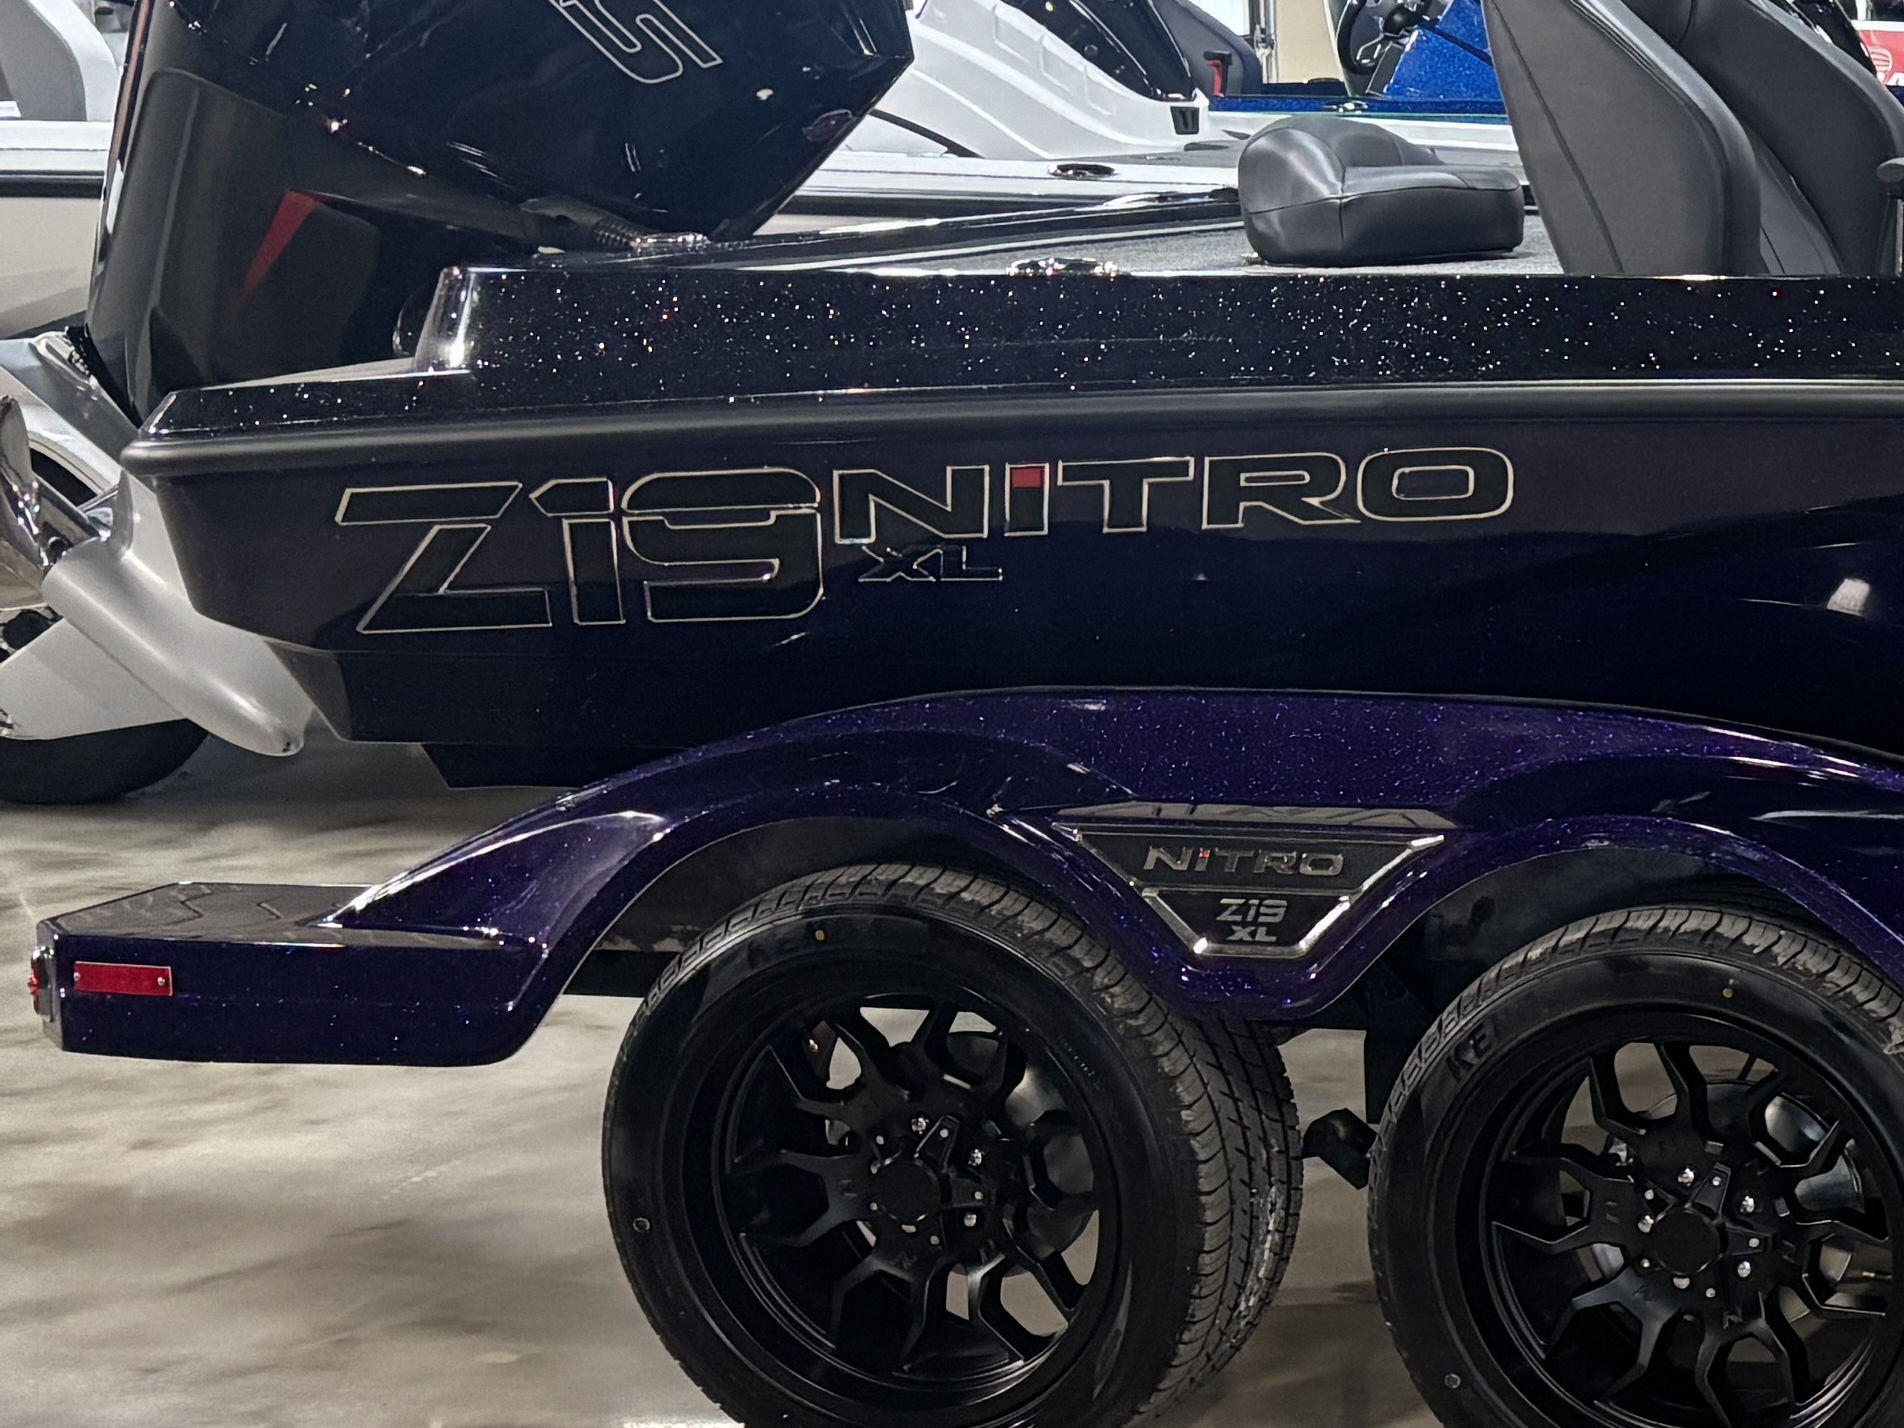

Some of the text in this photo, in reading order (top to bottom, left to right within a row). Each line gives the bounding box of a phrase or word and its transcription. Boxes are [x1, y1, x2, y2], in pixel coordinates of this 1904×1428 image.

[334, 446, 1516, 634] Z19 NITRO
[857, 544, 1004, 582] XL
[1143, 846, 1345, 877] NITRO
[1215, 898, 1289, 924] Z19
[1227, 925, 1278, 943] XL
